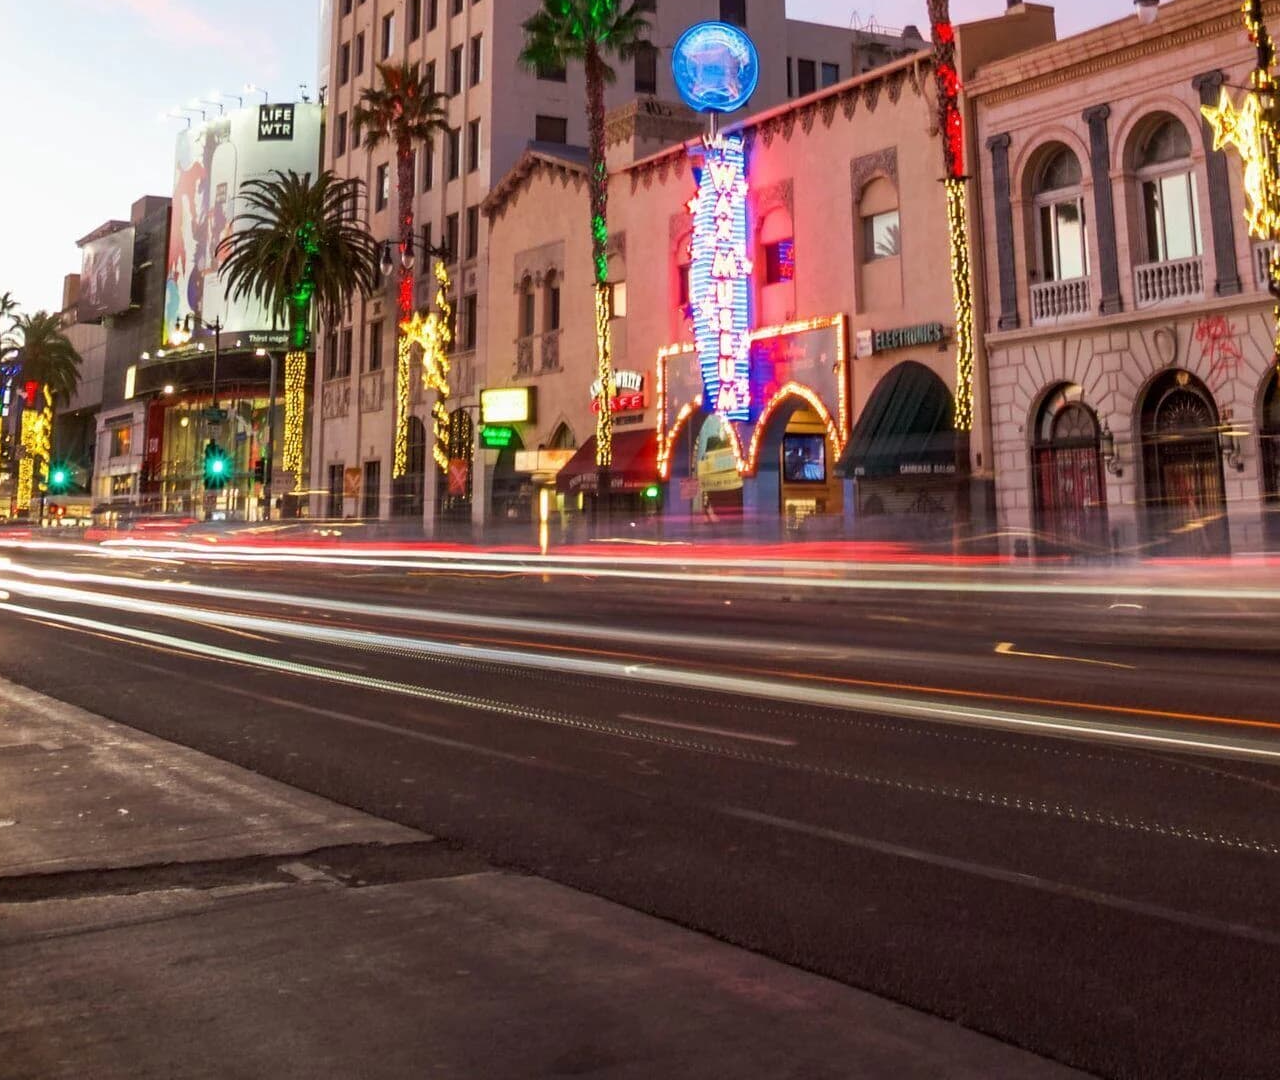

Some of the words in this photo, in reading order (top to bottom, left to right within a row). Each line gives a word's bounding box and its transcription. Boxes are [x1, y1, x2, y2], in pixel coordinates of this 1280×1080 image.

[260, 123, 291, 137] WTR
[261, 108, 292, 122] LIFE
[707, 161, 738, 241] WAX
[710, 248, 739, 412] MUSEUM
[875, 322, 942, 352] ELECTRONICS
